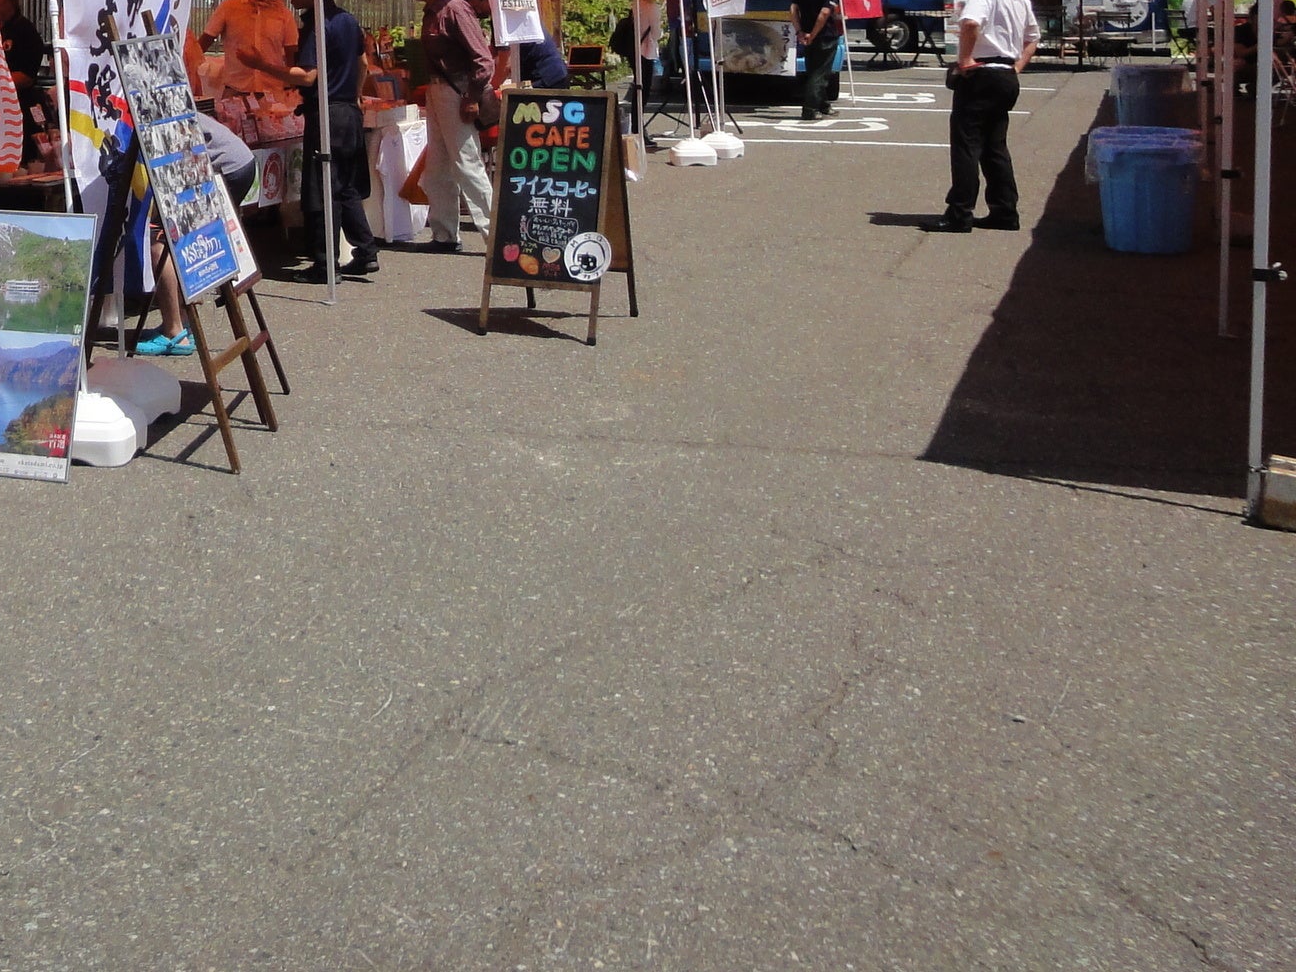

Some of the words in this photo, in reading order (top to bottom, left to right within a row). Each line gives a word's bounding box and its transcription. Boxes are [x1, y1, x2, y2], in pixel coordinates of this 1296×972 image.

[512, 100, 585, 124] MSG
[525, 124, 590, 149] CAFE
[509, 147, 597, 172] OPEN
[509, 176, 597, 198] アイスコーヒー
[528, 197, 573, 217] 無料
